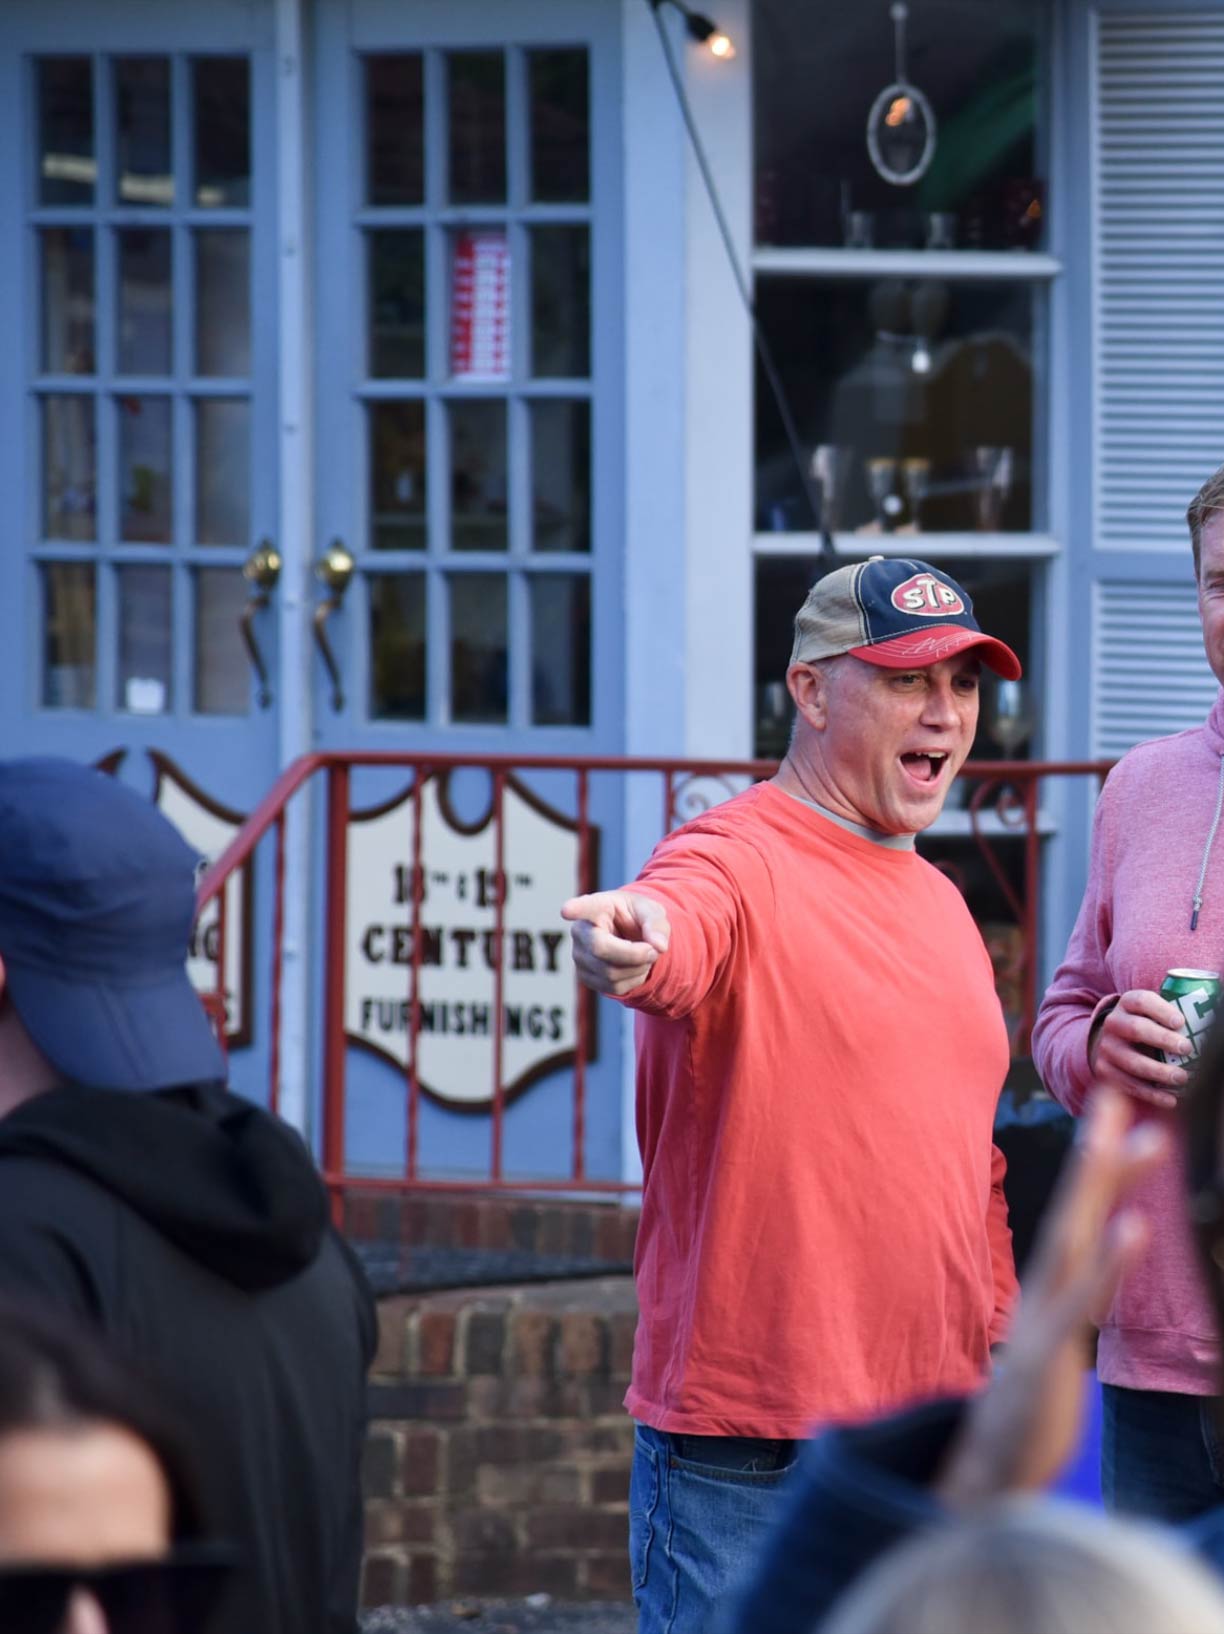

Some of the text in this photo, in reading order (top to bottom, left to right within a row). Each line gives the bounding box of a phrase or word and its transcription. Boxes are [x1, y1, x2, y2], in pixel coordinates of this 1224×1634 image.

[903, 579, 957, 609] STP
[362, 924, 565, 972] CENTURY
[361, 997, 566, 1041] FURNISHNGS
